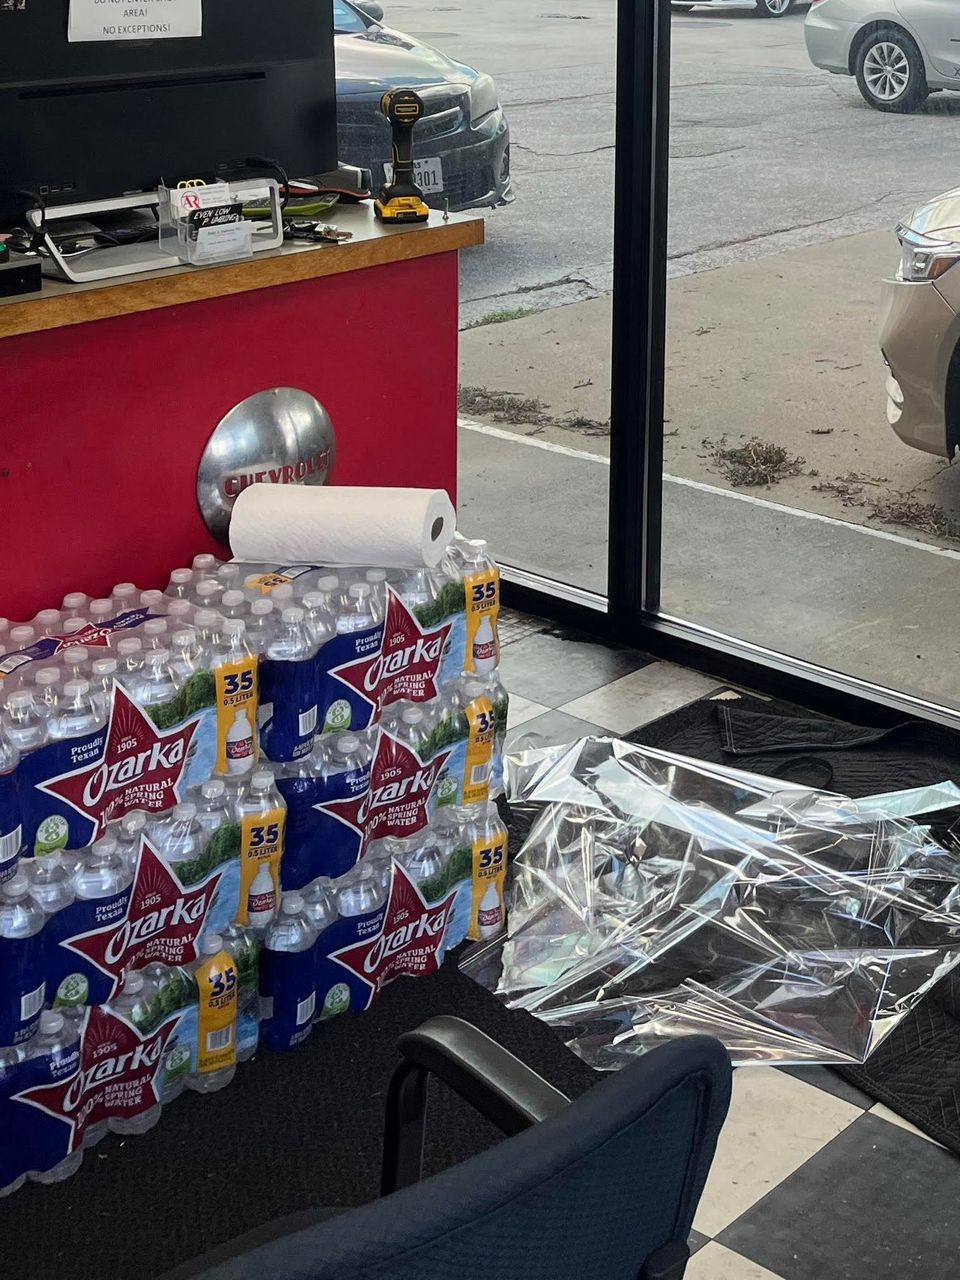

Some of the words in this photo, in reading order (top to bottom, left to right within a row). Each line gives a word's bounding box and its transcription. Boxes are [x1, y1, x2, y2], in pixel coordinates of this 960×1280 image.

[123, 8, 148, 17] AREA!
[102, 26, 115, 35] NO
[118, 24, 171, 34] EXCEPTIONS!
[413, 170, 438, 187] 301
[194, 209, 213, 220] EVEN
[215, 207, 231, 216] LOW
[202, 213, 239, 225] PUMBING
[471, 581, 496, 602] 35
[355, 640, 378, 653] Texan
[389, 635, 405, 647] 1905
[364, 637, 443, 692] Ozarka
[223, 669, 253, 695] 35
[394, 670, 434, 684] NATURAL
[393, 680, 426, 690] SPRING
[223, 697, 234, 706] 0.5
[235, 693, 254, 704] LITER
[116, 737, 138, 754] 1905
[70, 748, 99, 763] Texan
[82, 738, 185, 807] Ozarka
[380, 768, 402, 781] 1905
[124, 777, 174, 796] NATURAL
[123, 790, 165, 802] SPRING
[123, 799, 163, 809] WATER
[388, 797, 426, 812] NATURAL
[386, 816, 417, 826] WATER
[387, 808, 418, 820] SPRING
[250, 823, 279, 847] 35
[248, 849, 259, 858] 0.5
[260, 846, 278, 855] LITER
[479, 845, 503, 868] 35
[95, 895, 128, 914] Proudly
[140, 893, 162, 910] 1905
[95, 907, 124, 922] Texan
[104, 893, 206, 964] Ozarka
[356, 923, 380, 936] Texan
[146, 933, 195, 951] NATURAL
[364, 909, 446, 974] Ozarka
[144, 945, 184, 956] SPRING
[396, 944, 436, 958] NATURAL
[208, 967, 236, 997] 35
[92, 1043, 118, 1059] 1905
[104, 1073, 152, 1093] NATURAL
[103, 1088, 143, 1100] SPRING
[104, 1096, 142, 1108] WATER
